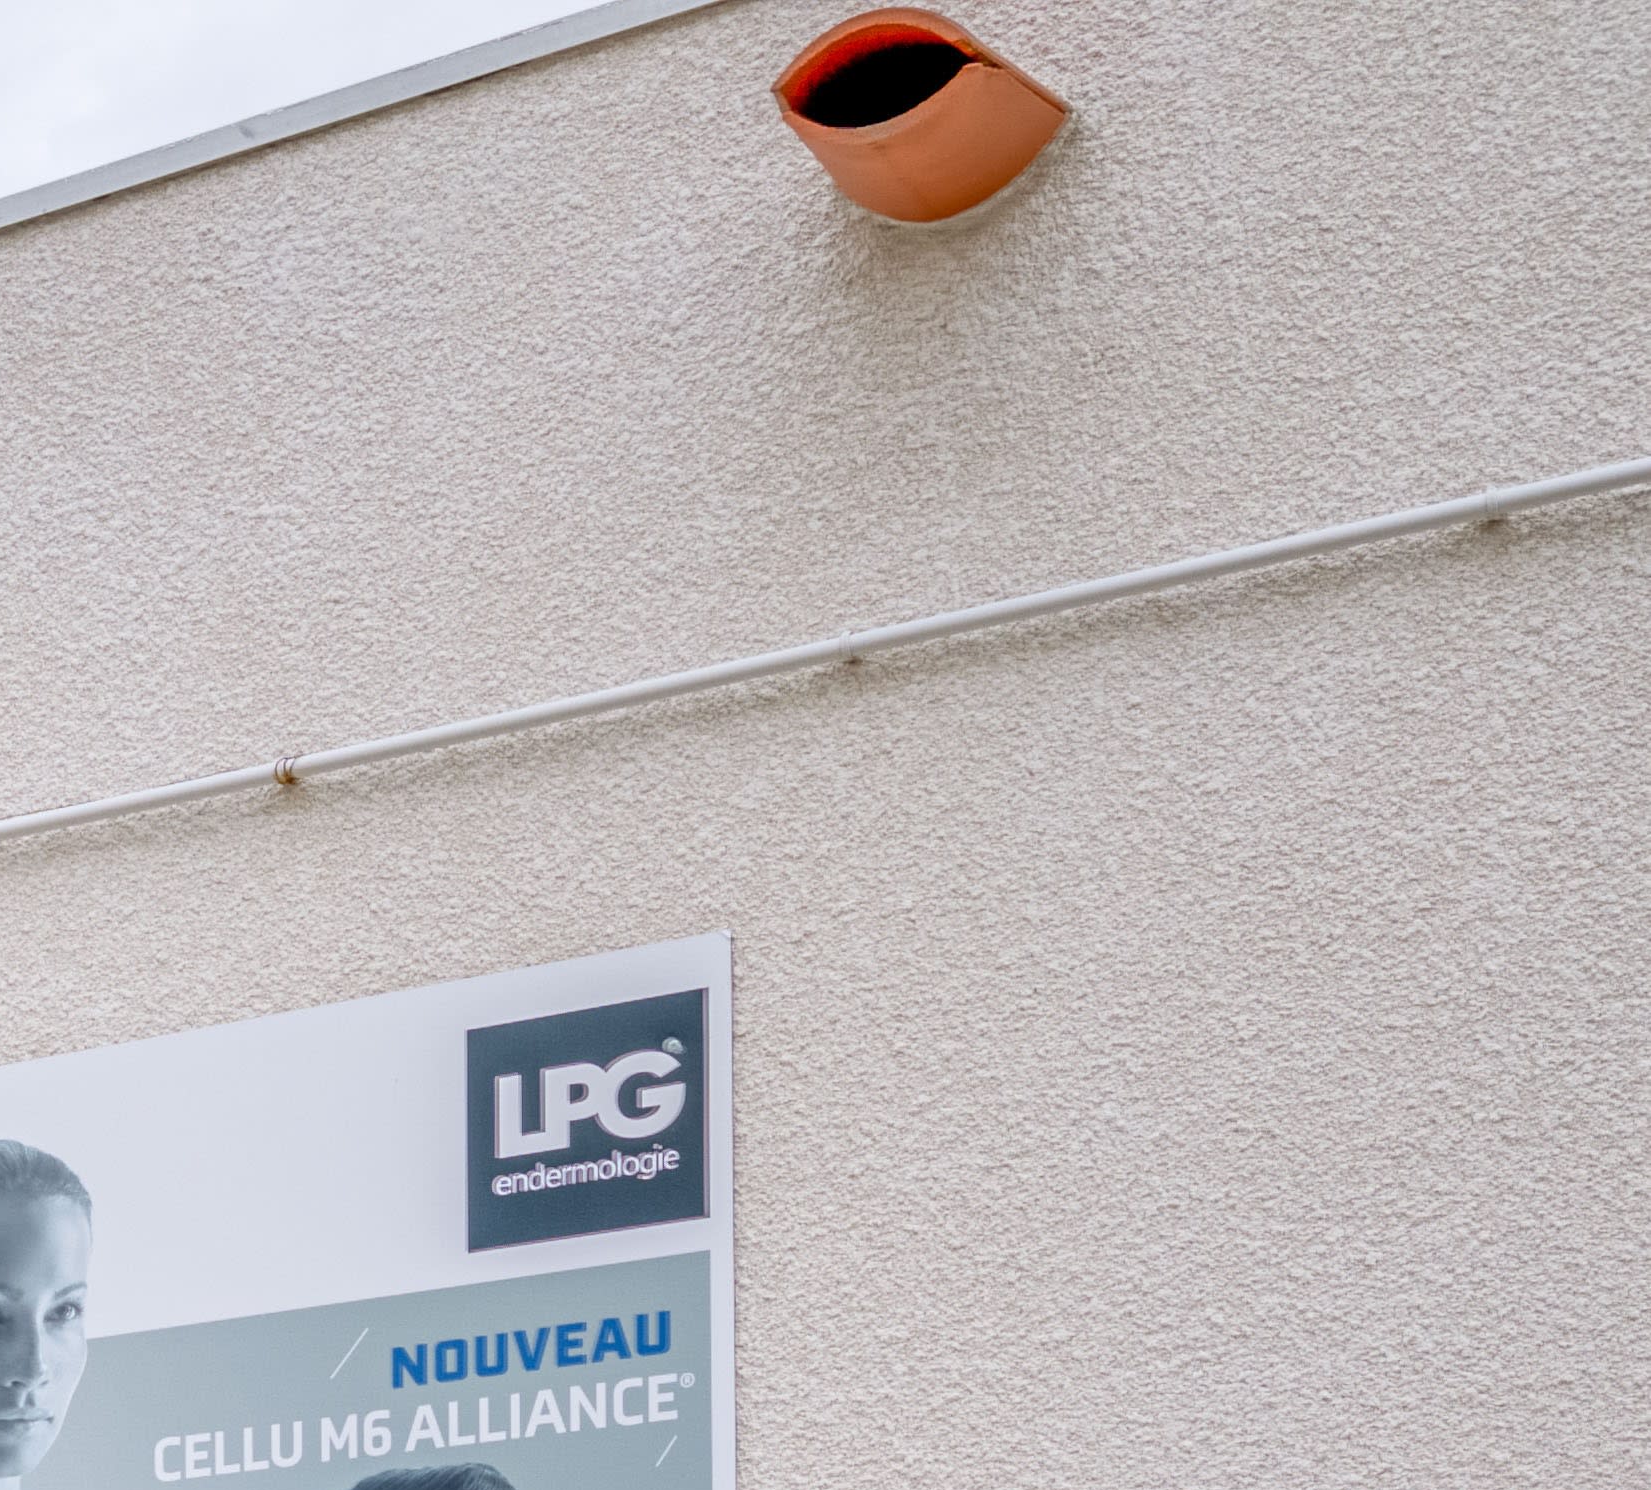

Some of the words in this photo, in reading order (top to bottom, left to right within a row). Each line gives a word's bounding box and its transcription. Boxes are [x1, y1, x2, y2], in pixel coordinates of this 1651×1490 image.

[495, 1048, 687, 1160] LPG
[492, 1143, 681, 1197] endermologie
[390, 1309, 672, 1389] NOUVEAU
[153, 1419, 304, 1482] CELLU
[320, 1408, 393, 1463] M6
